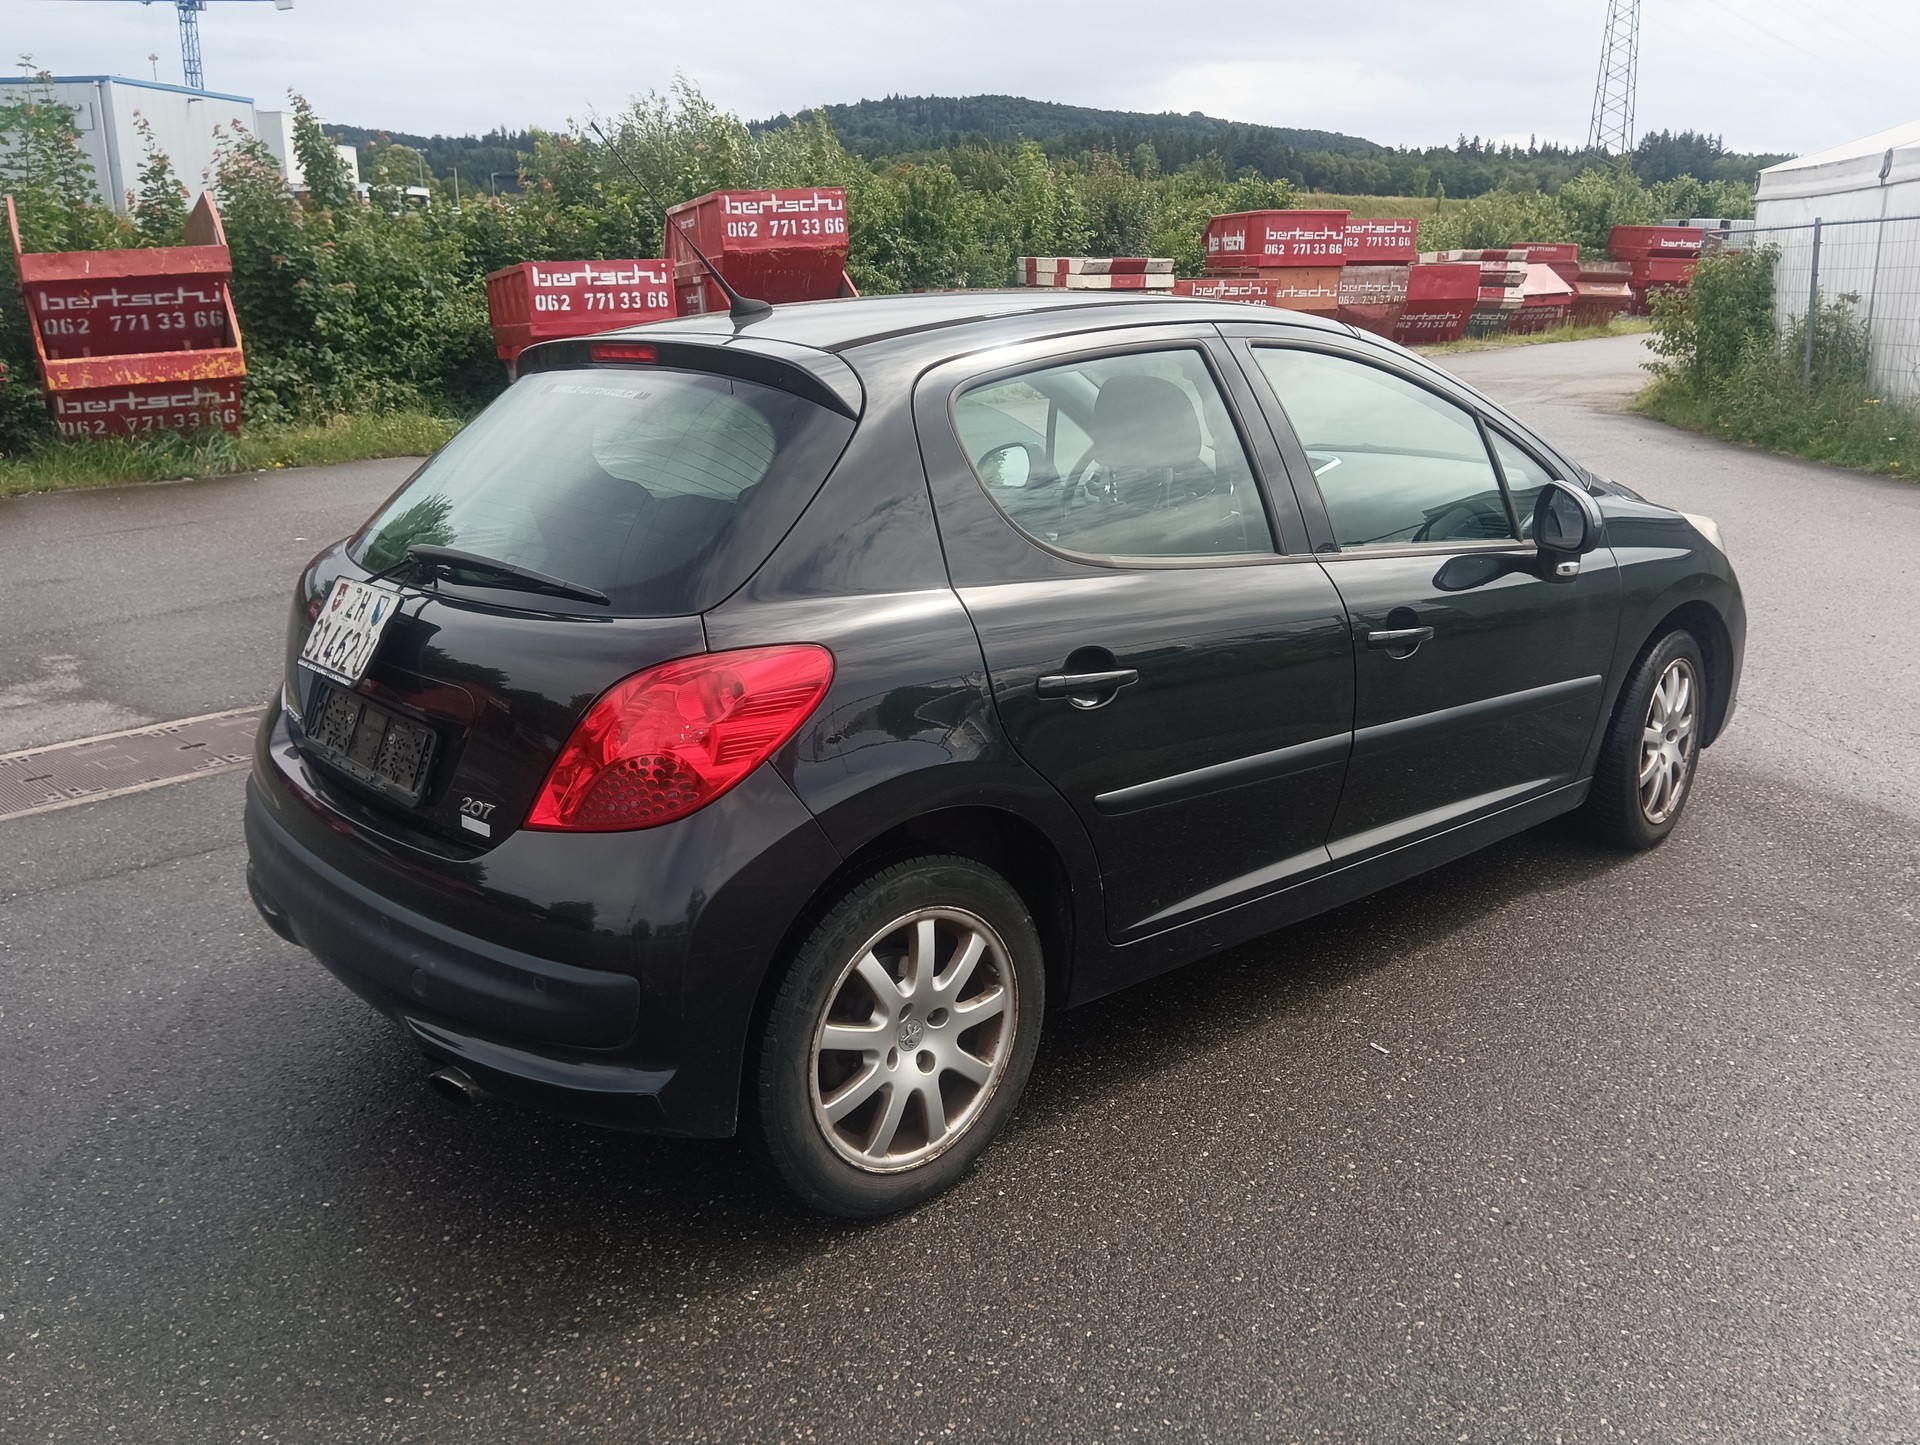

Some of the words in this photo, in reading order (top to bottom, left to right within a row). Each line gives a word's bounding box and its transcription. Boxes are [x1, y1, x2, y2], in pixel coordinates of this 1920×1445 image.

[725, 191, 843, 214] bertschi
[727, 221, 758, 237] 062
[769, 219, 797, 236] 771
[801, 218, 820, 235] 33
[825, 217, 845, 234] 66
[1266, 226, 1344, 240] bertschi
[1264, 243, 1285, 255] 062
[1293, 243, 1311, 255] 771
[1313, 243, 1326, 255] 33
[1329, 243, 1342, 254] 66
[1366, 236, 1382, 247] 771
[1384, 236, 1396, 247] 33
[1398, 236, 1411, 247] 66
[532, 263, 667, 286] bertschi
[40, 282, 221, 311] bertschi
[535, 294, 571, 311] 062
[584, 292, 615, 310] 771
[620, 291, 641, 309] 33
[648, 291, 669, 308] 66
[43, 318, 90, 335] 062
[109, 314, 150, 332] 771
[157, 311, 186, 329] 33
[194, 310, 224, 328] 66
[57, 383, 236, 414] bertschi
[459, 796, 497, 820] 207
